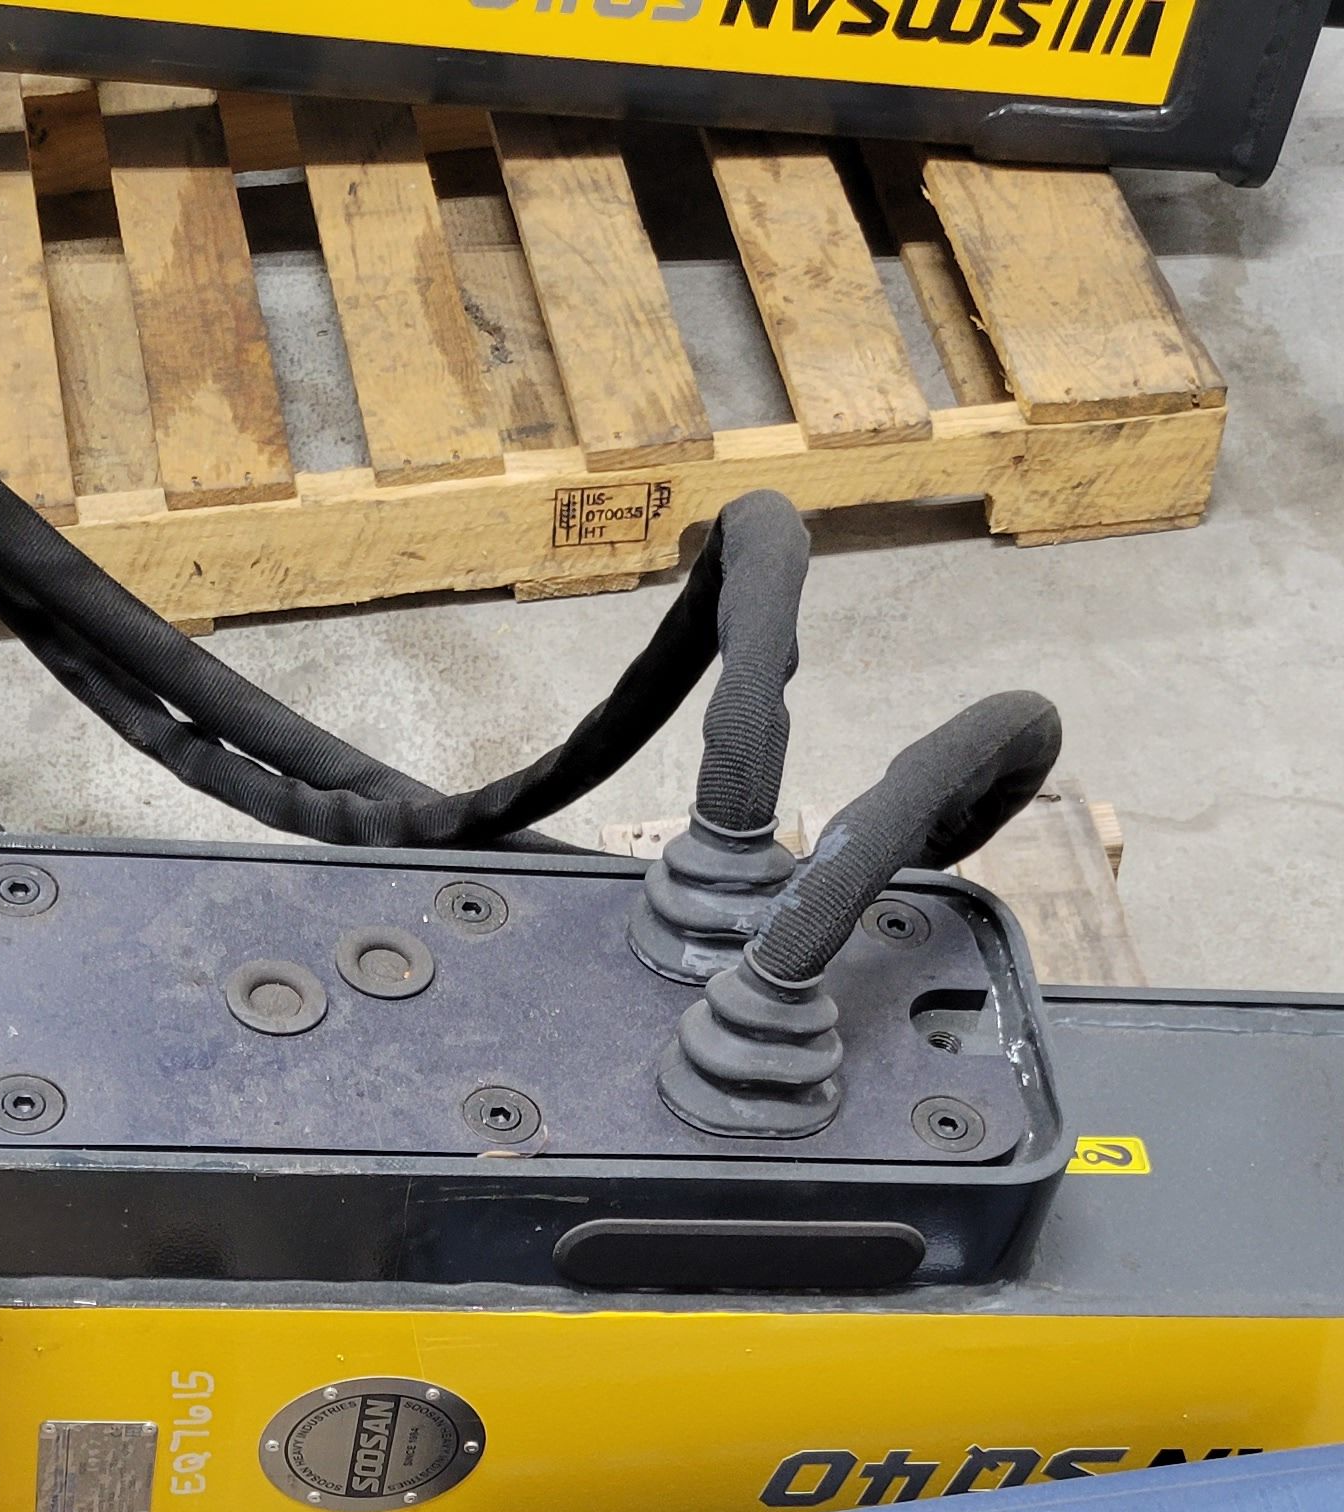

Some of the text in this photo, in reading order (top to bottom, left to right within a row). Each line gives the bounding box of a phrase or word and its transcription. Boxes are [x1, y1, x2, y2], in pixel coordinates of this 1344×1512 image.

[584, 526, 607, 538] HT
[403, 1401, 444, 1427] SOOSAN
[292, 1401, 357, 1491] SOOSAN HEAVY INDUSTRIES
[351, 1399, 395, 1493] SOOSAN
[758, 1449, 941, 1507] 40
